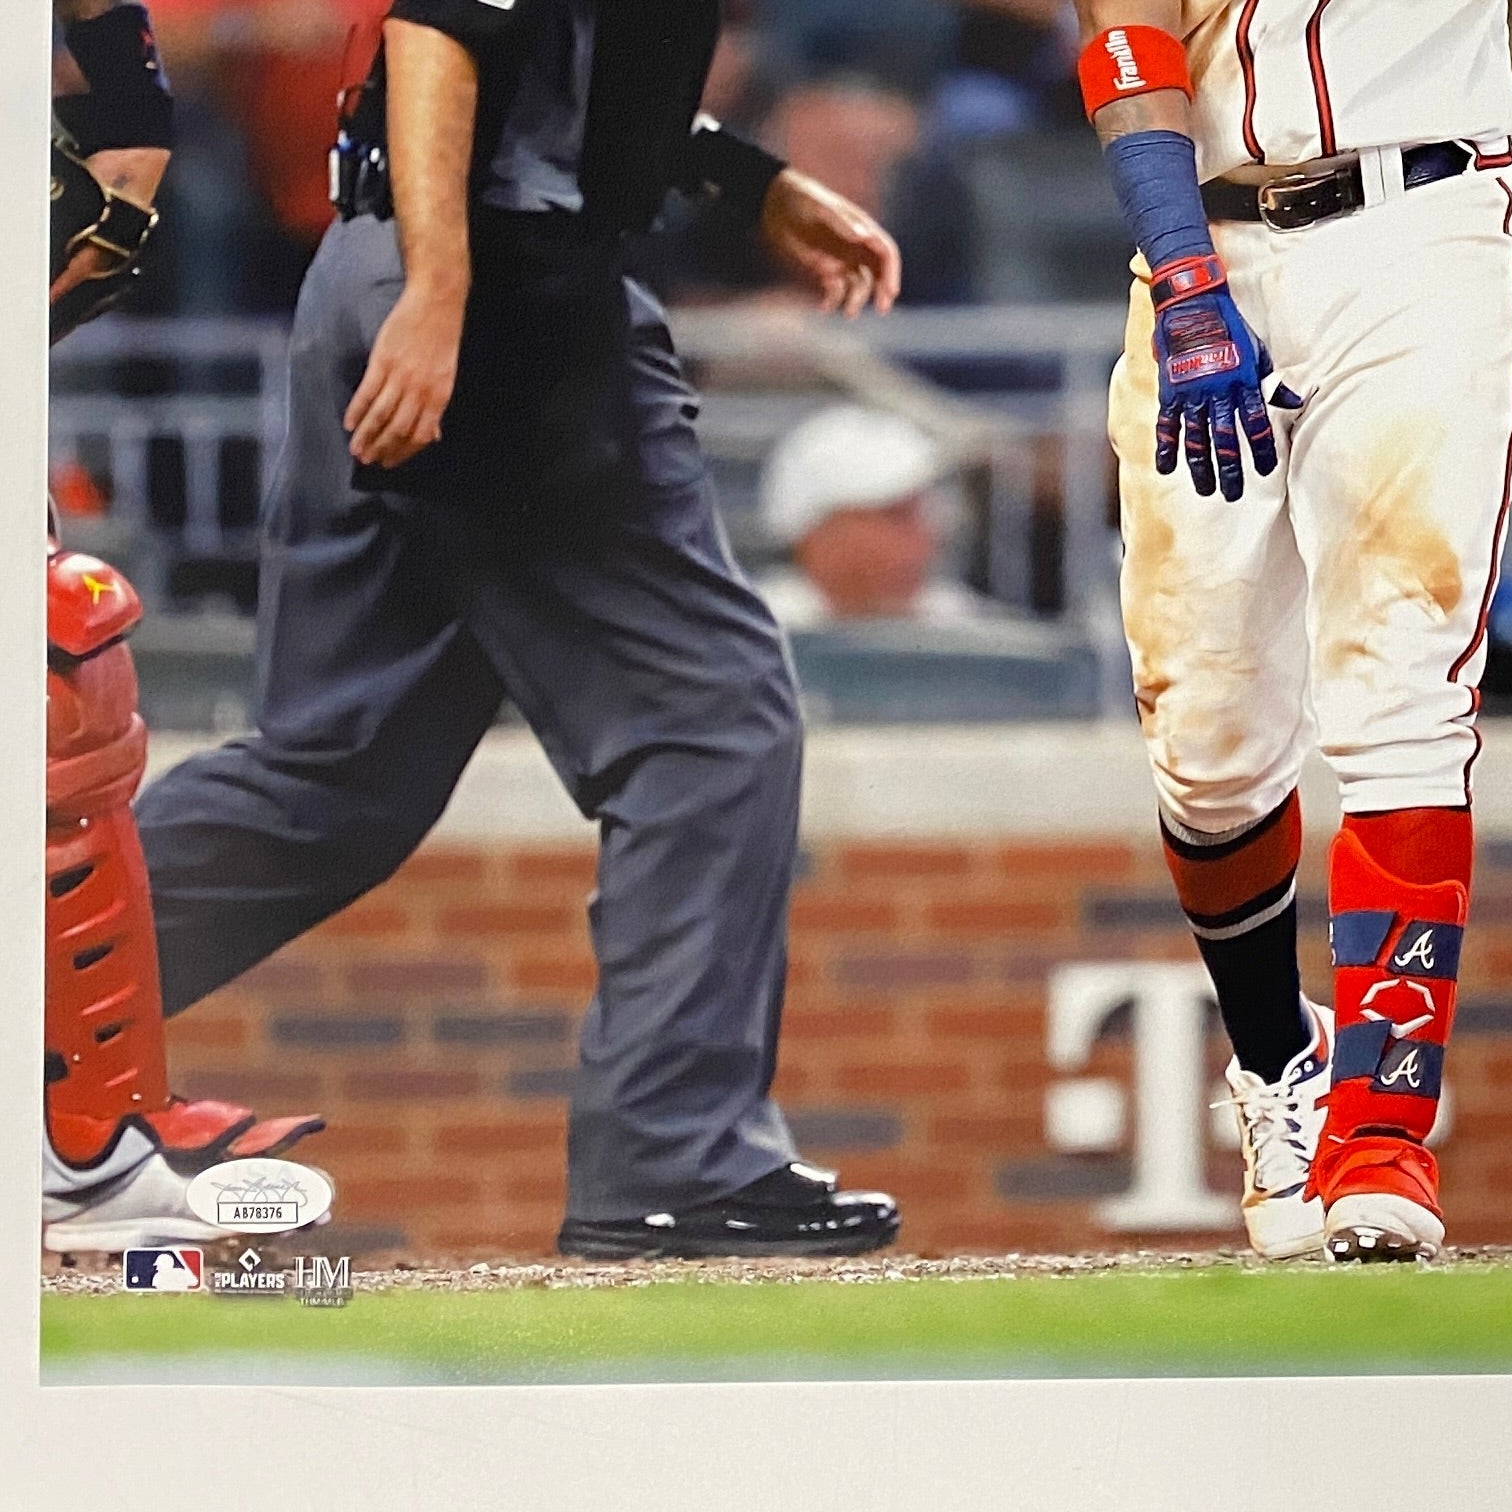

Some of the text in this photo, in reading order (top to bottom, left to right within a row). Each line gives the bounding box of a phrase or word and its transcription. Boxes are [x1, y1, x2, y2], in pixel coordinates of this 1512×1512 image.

[1394, 929, 1435, 969] A
[1380, 1048, 1421, 1088] A
[233, 1207, 282, 1219] AB78376
[221, 1272, 285, 1288] PLAYERS
